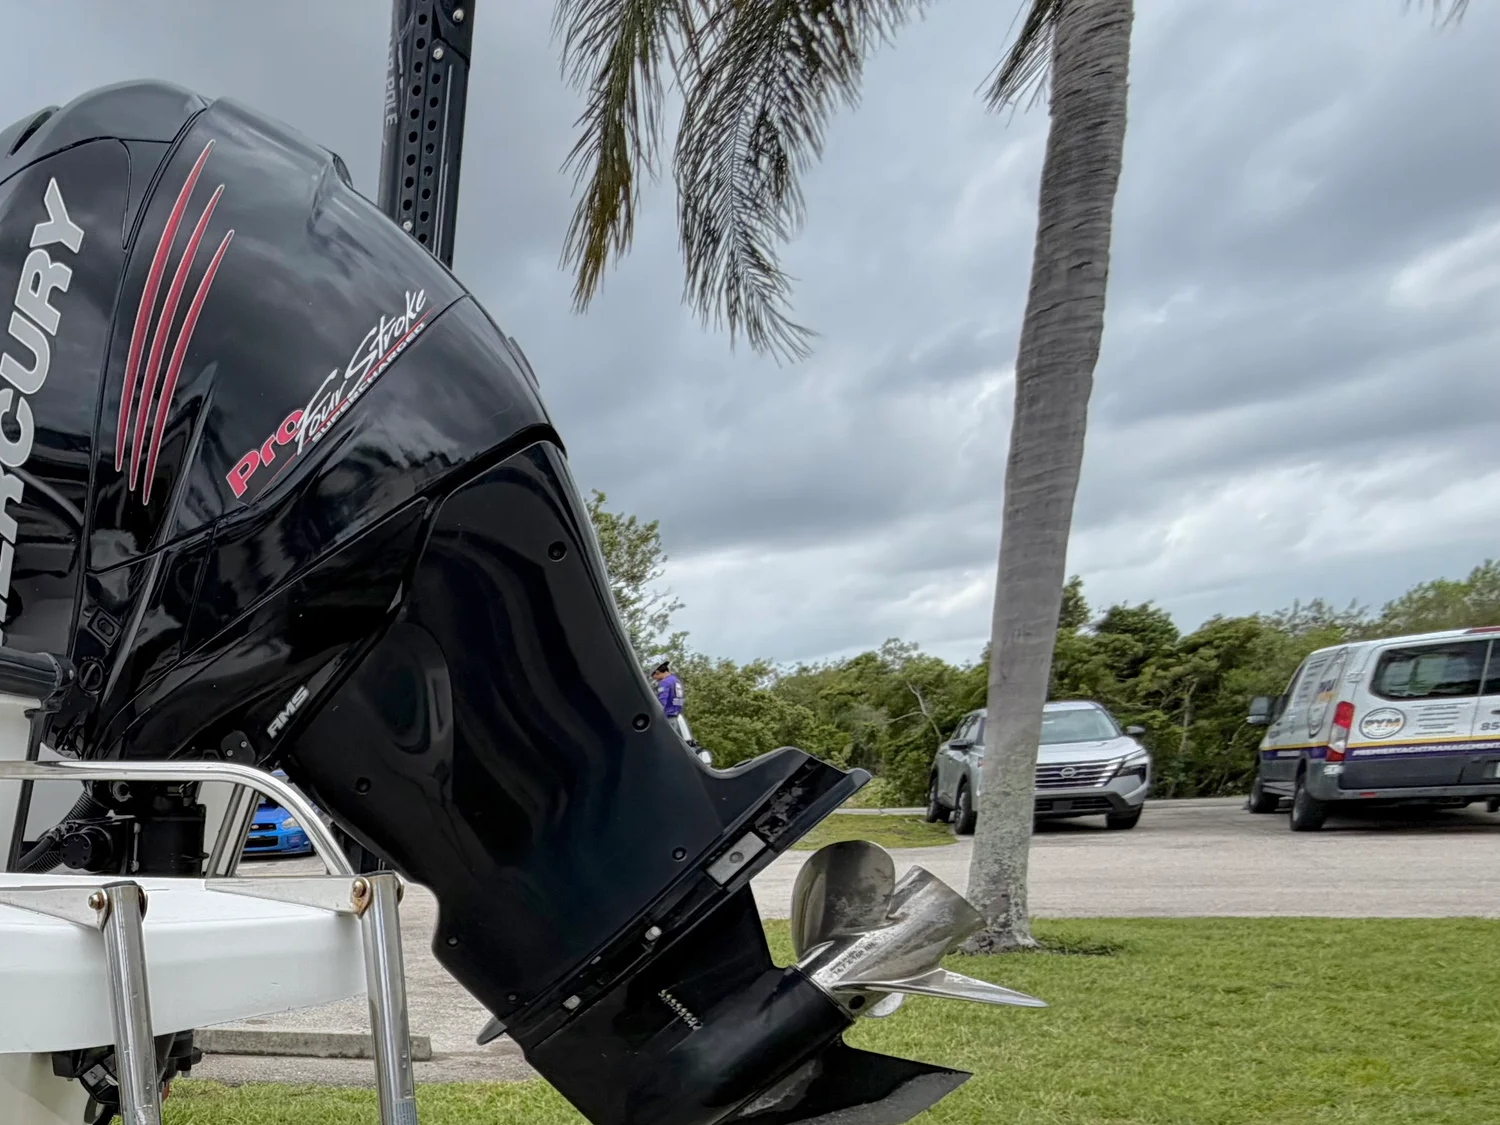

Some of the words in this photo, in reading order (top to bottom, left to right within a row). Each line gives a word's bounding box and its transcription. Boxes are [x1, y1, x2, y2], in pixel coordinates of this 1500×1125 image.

[312, 322, 425, 443] SUPERCHARGED
[226, 409, 304, 498] Pro
[267, 685, 310, 739] AMS
